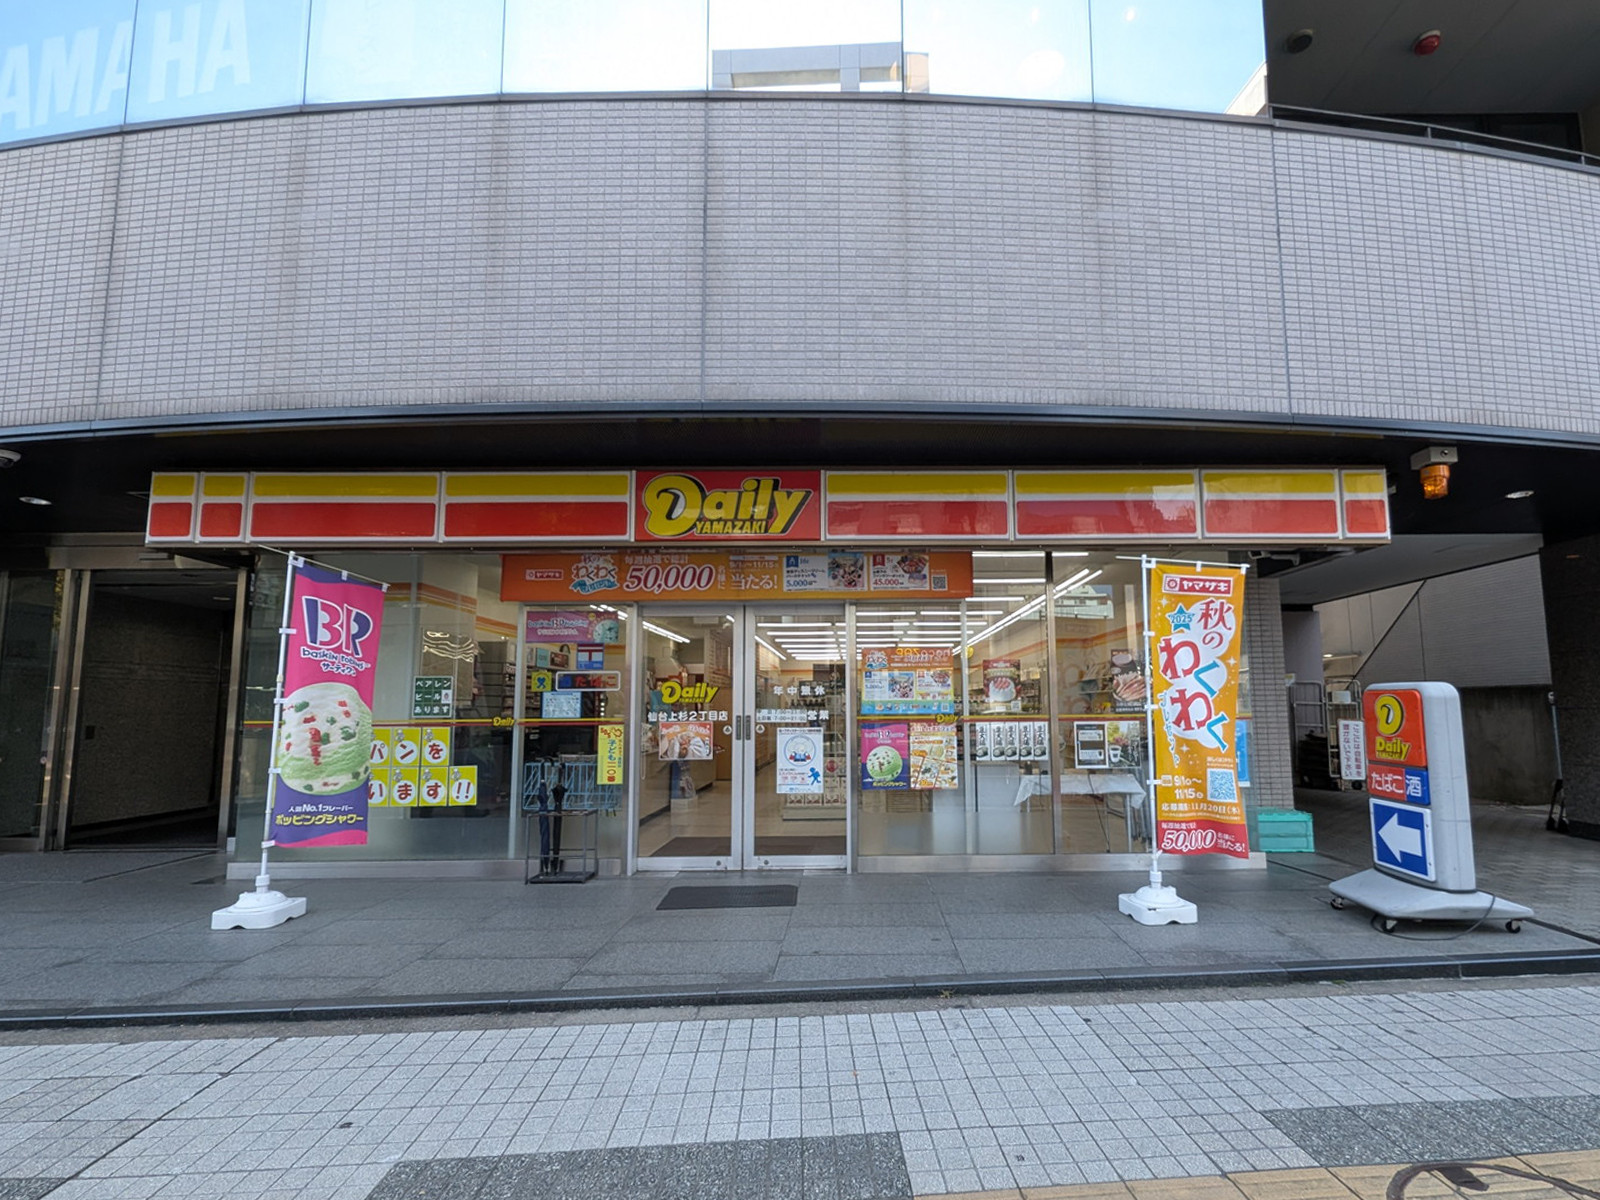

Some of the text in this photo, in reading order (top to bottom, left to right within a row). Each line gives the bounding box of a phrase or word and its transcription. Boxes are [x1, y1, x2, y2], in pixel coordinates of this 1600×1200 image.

[644, 474, 811, 537] Daily
[696, 521, 767, 534] YAMAZAKI
[574, 565, 617, 581] わくわく
[624, 564, 715, 593] 50,000
[731, 573, 778, 590] 当たる!
[1182, 580, 1229, 592] ヤマザキ
[302, 595, 373, 658] BR
[1170, 613, 1193, 624] 2025
[1197, 599, 1233, 650] 秋の
[661, 681, 719, 704] Daily
[414, 705, 450, 714] あります
[1376, 736, 1411, 760] Daily
[1371, 772, 1422, 797] たばこ 酒
[276, 814, 364, 825] ポッピングシャワー
